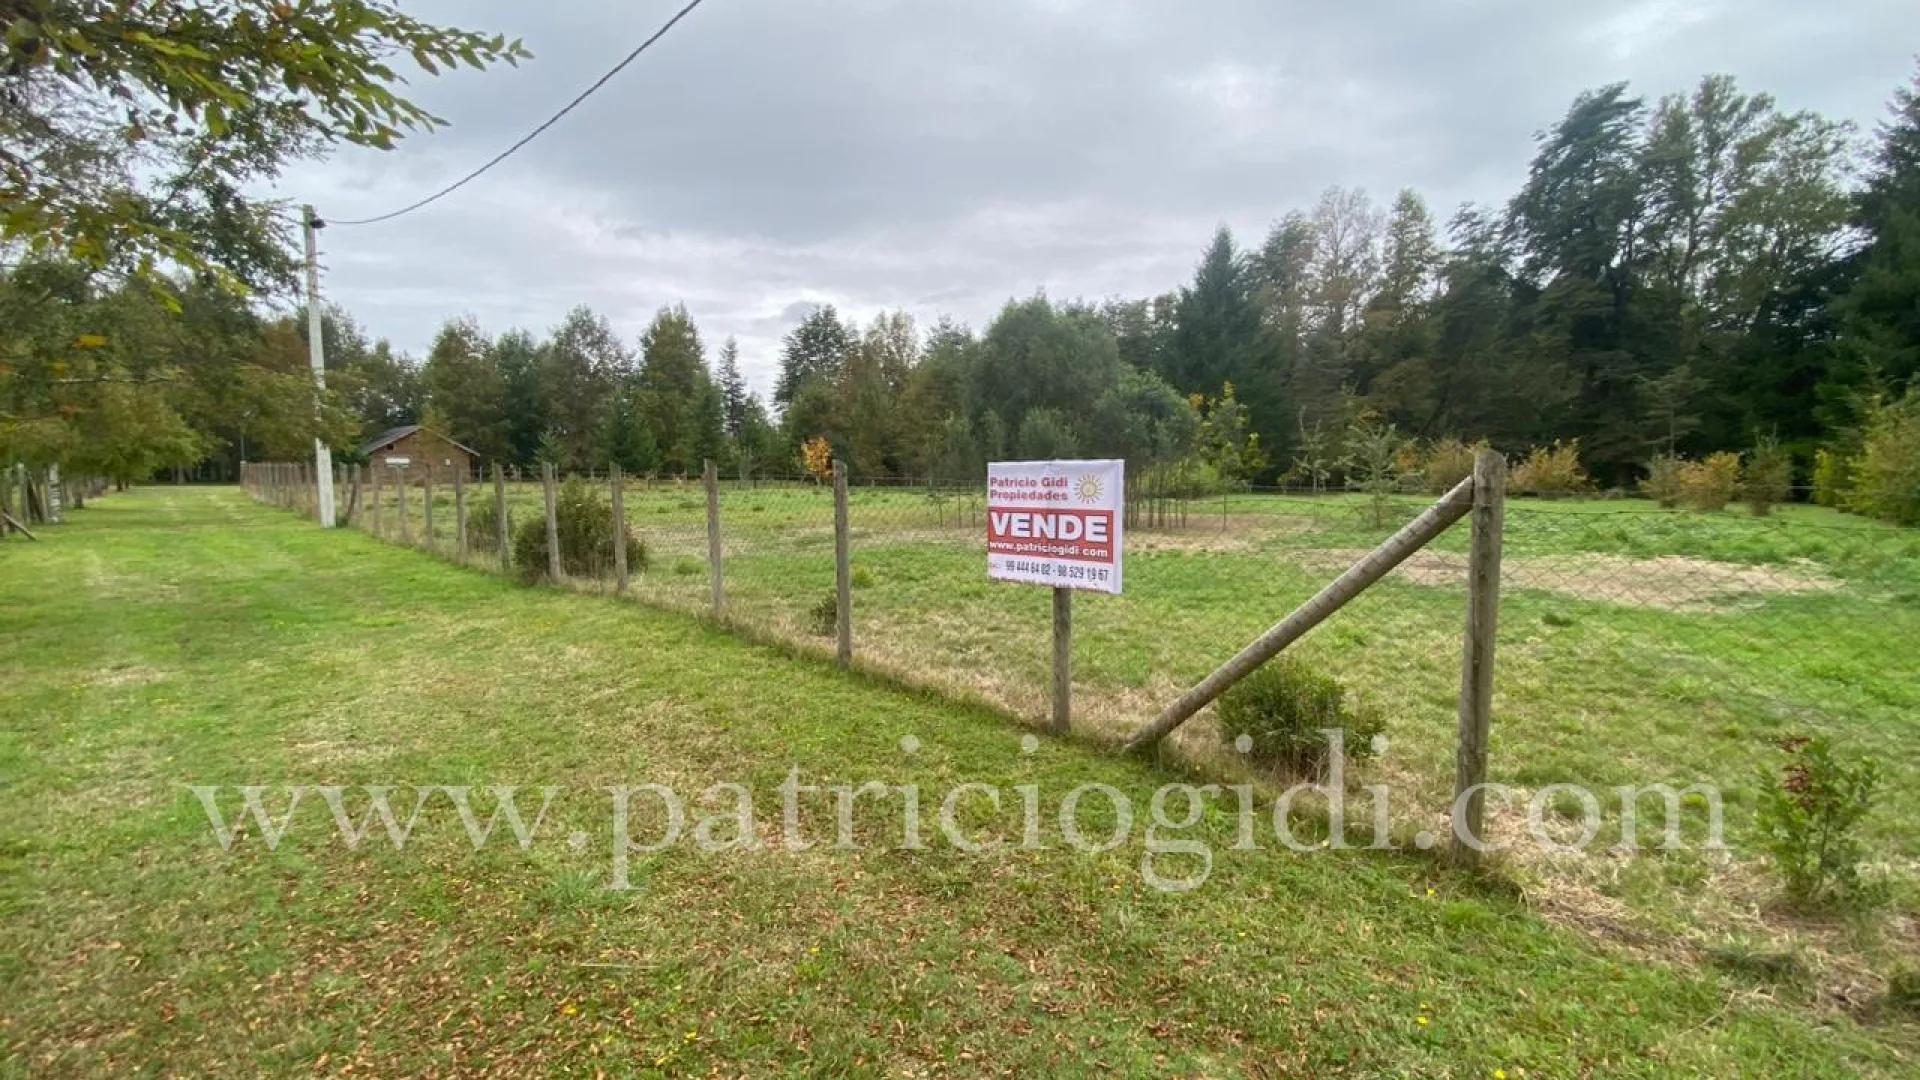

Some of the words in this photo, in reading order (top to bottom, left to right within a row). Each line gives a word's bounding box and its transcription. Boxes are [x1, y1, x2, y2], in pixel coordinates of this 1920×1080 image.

[990, 477, 1037, 487] Patricio
[1041, 477, 1069, 487] Gidi
[990, 490, 1068, 501] Propiedades
[990, 512, 1108, 542] VENDE
